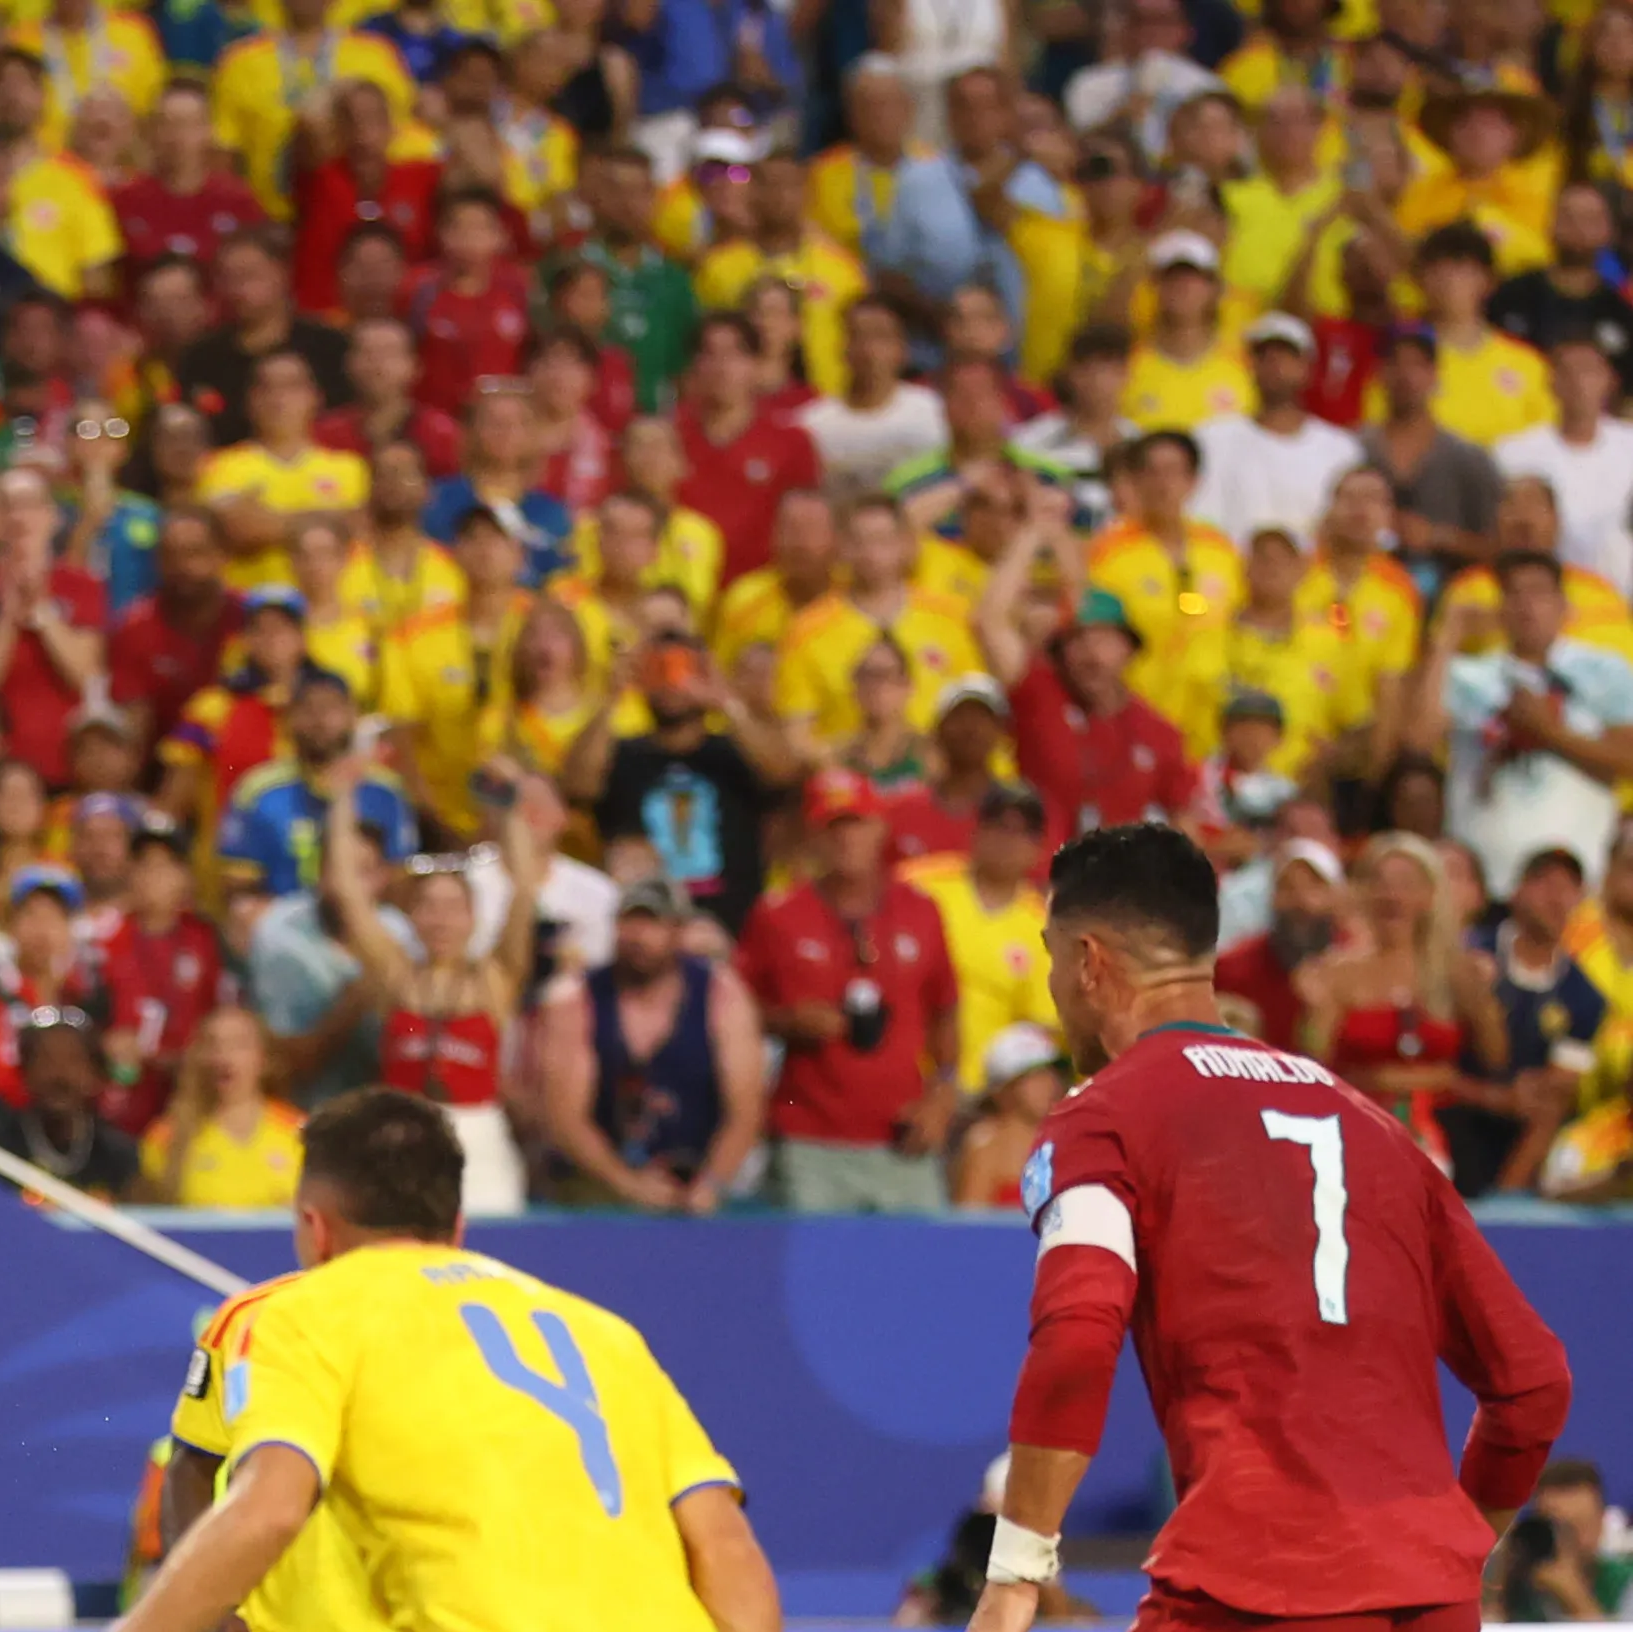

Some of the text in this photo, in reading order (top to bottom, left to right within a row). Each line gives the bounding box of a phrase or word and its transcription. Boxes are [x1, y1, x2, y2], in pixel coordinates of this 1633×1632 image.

[1182, 1044, 1336, 1087] RONALDO
[1260, 1108, 1348, 1325] 7
[459, 1302, 622, 1518] 4
